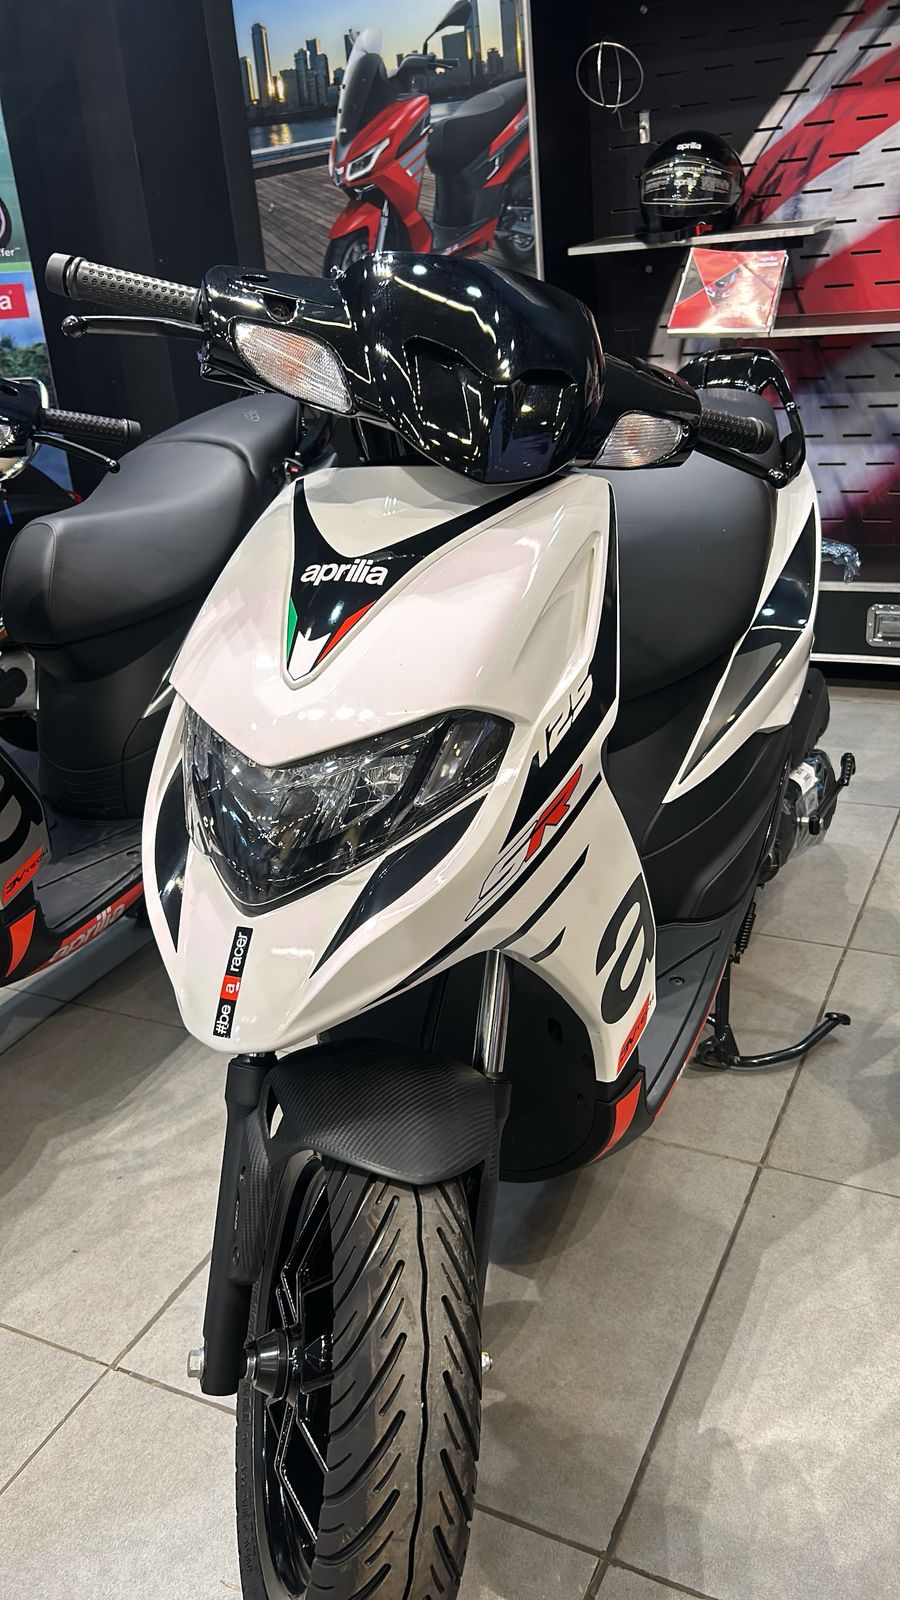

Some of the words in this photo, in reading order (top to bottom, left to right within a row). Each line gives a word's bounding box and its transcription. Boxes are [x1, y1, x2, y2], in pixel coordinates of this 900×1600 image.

[300, 558, 389, 586] aprilia
[537, 673, 594, 769] 125
[464, 763, 584, 922] SR
[48, 903, 126, 963] aprilia
[215, 1004, 232, 1036] #be
[229, 931, 249, 972] racer
